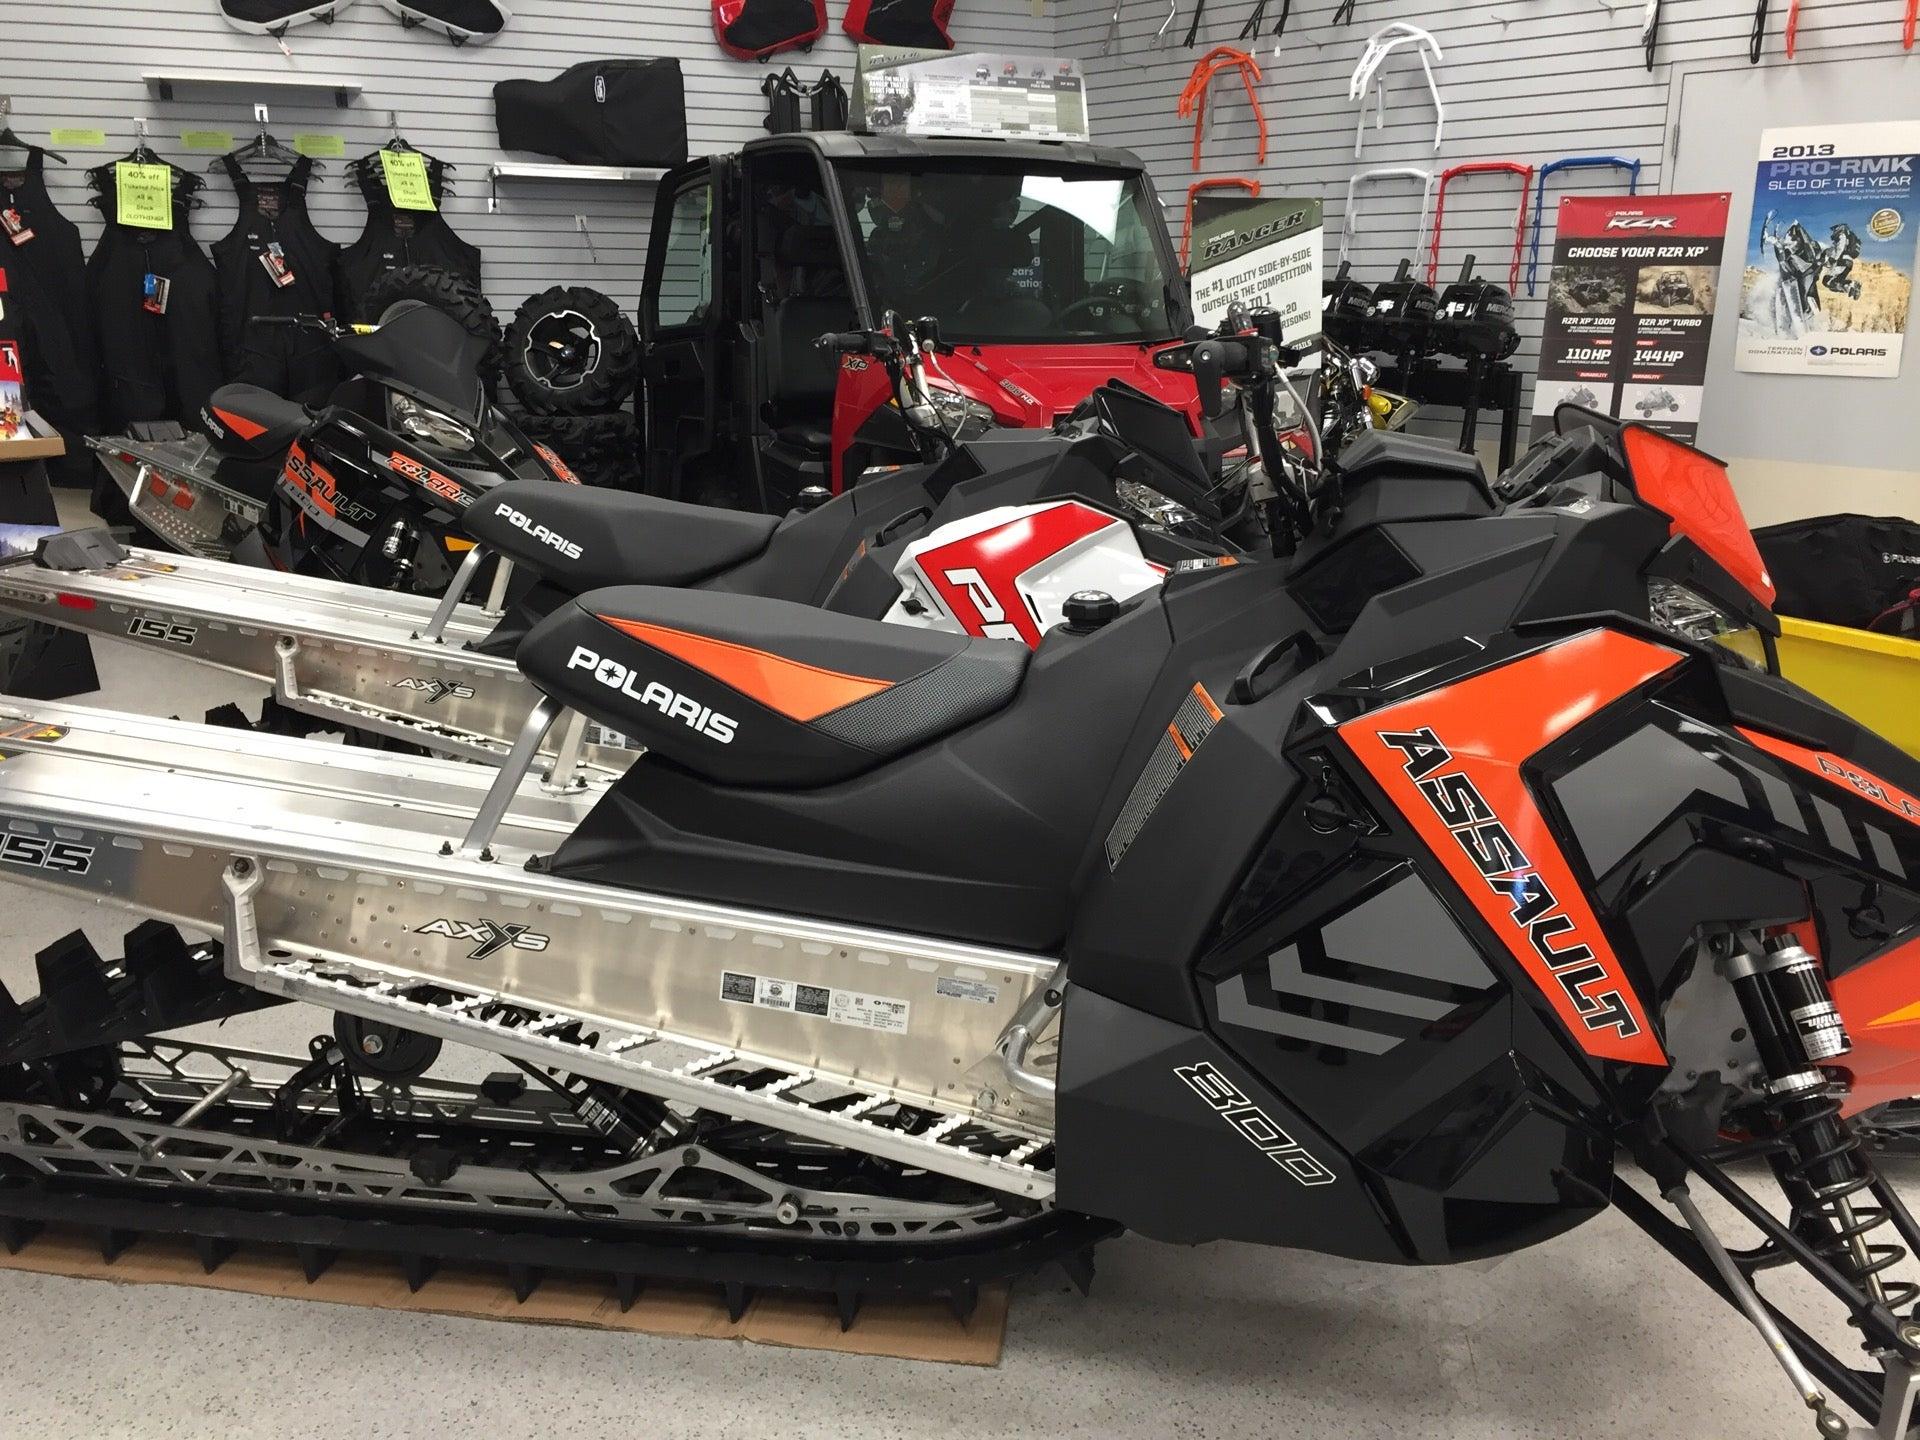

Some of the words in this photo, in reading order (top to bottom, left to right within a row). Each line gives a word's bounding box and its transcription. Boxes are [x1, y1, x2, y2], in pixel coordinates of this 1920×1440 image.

[1773, 144, 1835, 158] 2013
[128, 171, 146, 179] 40%
[1770, 157, 1915, 177] PRO-RMK
[1768, 180, 1807, 190] SLED
[1810, 178, 1832, 189] OF
[1834, 177, 1865, 188] THE
[1868, 175, 1911, 187] YEAR
[1604, 217, 1677, 230] RZR
[1202, 209, 1306, 260] RANGER
[1208, 229, 1236, 243] POLARIS
[1567, 247, 1619, 258] CHOOSE
[1621, 247, 1655, 258] YOUR
[1656, 247, 1684, 258] RZR
[1195, 286, 1211, 301] THE
[1211, 278, 1225, 292] #1
[1226, 268, 1257, 289] UTILITY
[1258, 247, 1312, 277] SIDE-BY-SIDE
[1201, 290, 1239, 314] OUTSELLS
[1240, 283, 1256, 298] THE
[1257, 261, 1313, 291] COMPETITION
[1249, 296, 1263, 308] TO
[1266, 292, 1272, 306] 1
[1285, 301, 1297, 314] 20
[1281, 310, 1312, 329] RISONS!
[1561, 317, 1579, 325] RZR
[1594, 317, 1616, 325] 1000
[1638, 318, 1657, 326] RZR
[1672, 318, 1702, 327] TURBO
[1566, 348, 1590, 360] 110
[1590, 349, 1612, 361] HP
[1633, 350, 1662, 362] 144
[1662, 351, 1684, 363] HP
[1830, 347, 1887, 357] POLARIS
[200, 406, 225, 440] POLARIS
[287, 455, 377, 522] SSAULT
[384, 456, 477, 509] POLARIS
[494, 502, 584, 560] POLARIS
[126, 616, 198, 646] 155
[566, 645, 740, 744] POLARIS
[0, 832, 95, 875] 55
[1375, 726, 1642, 1039] ASSAULT
[1173, 1061, 1337, 1186] 800
